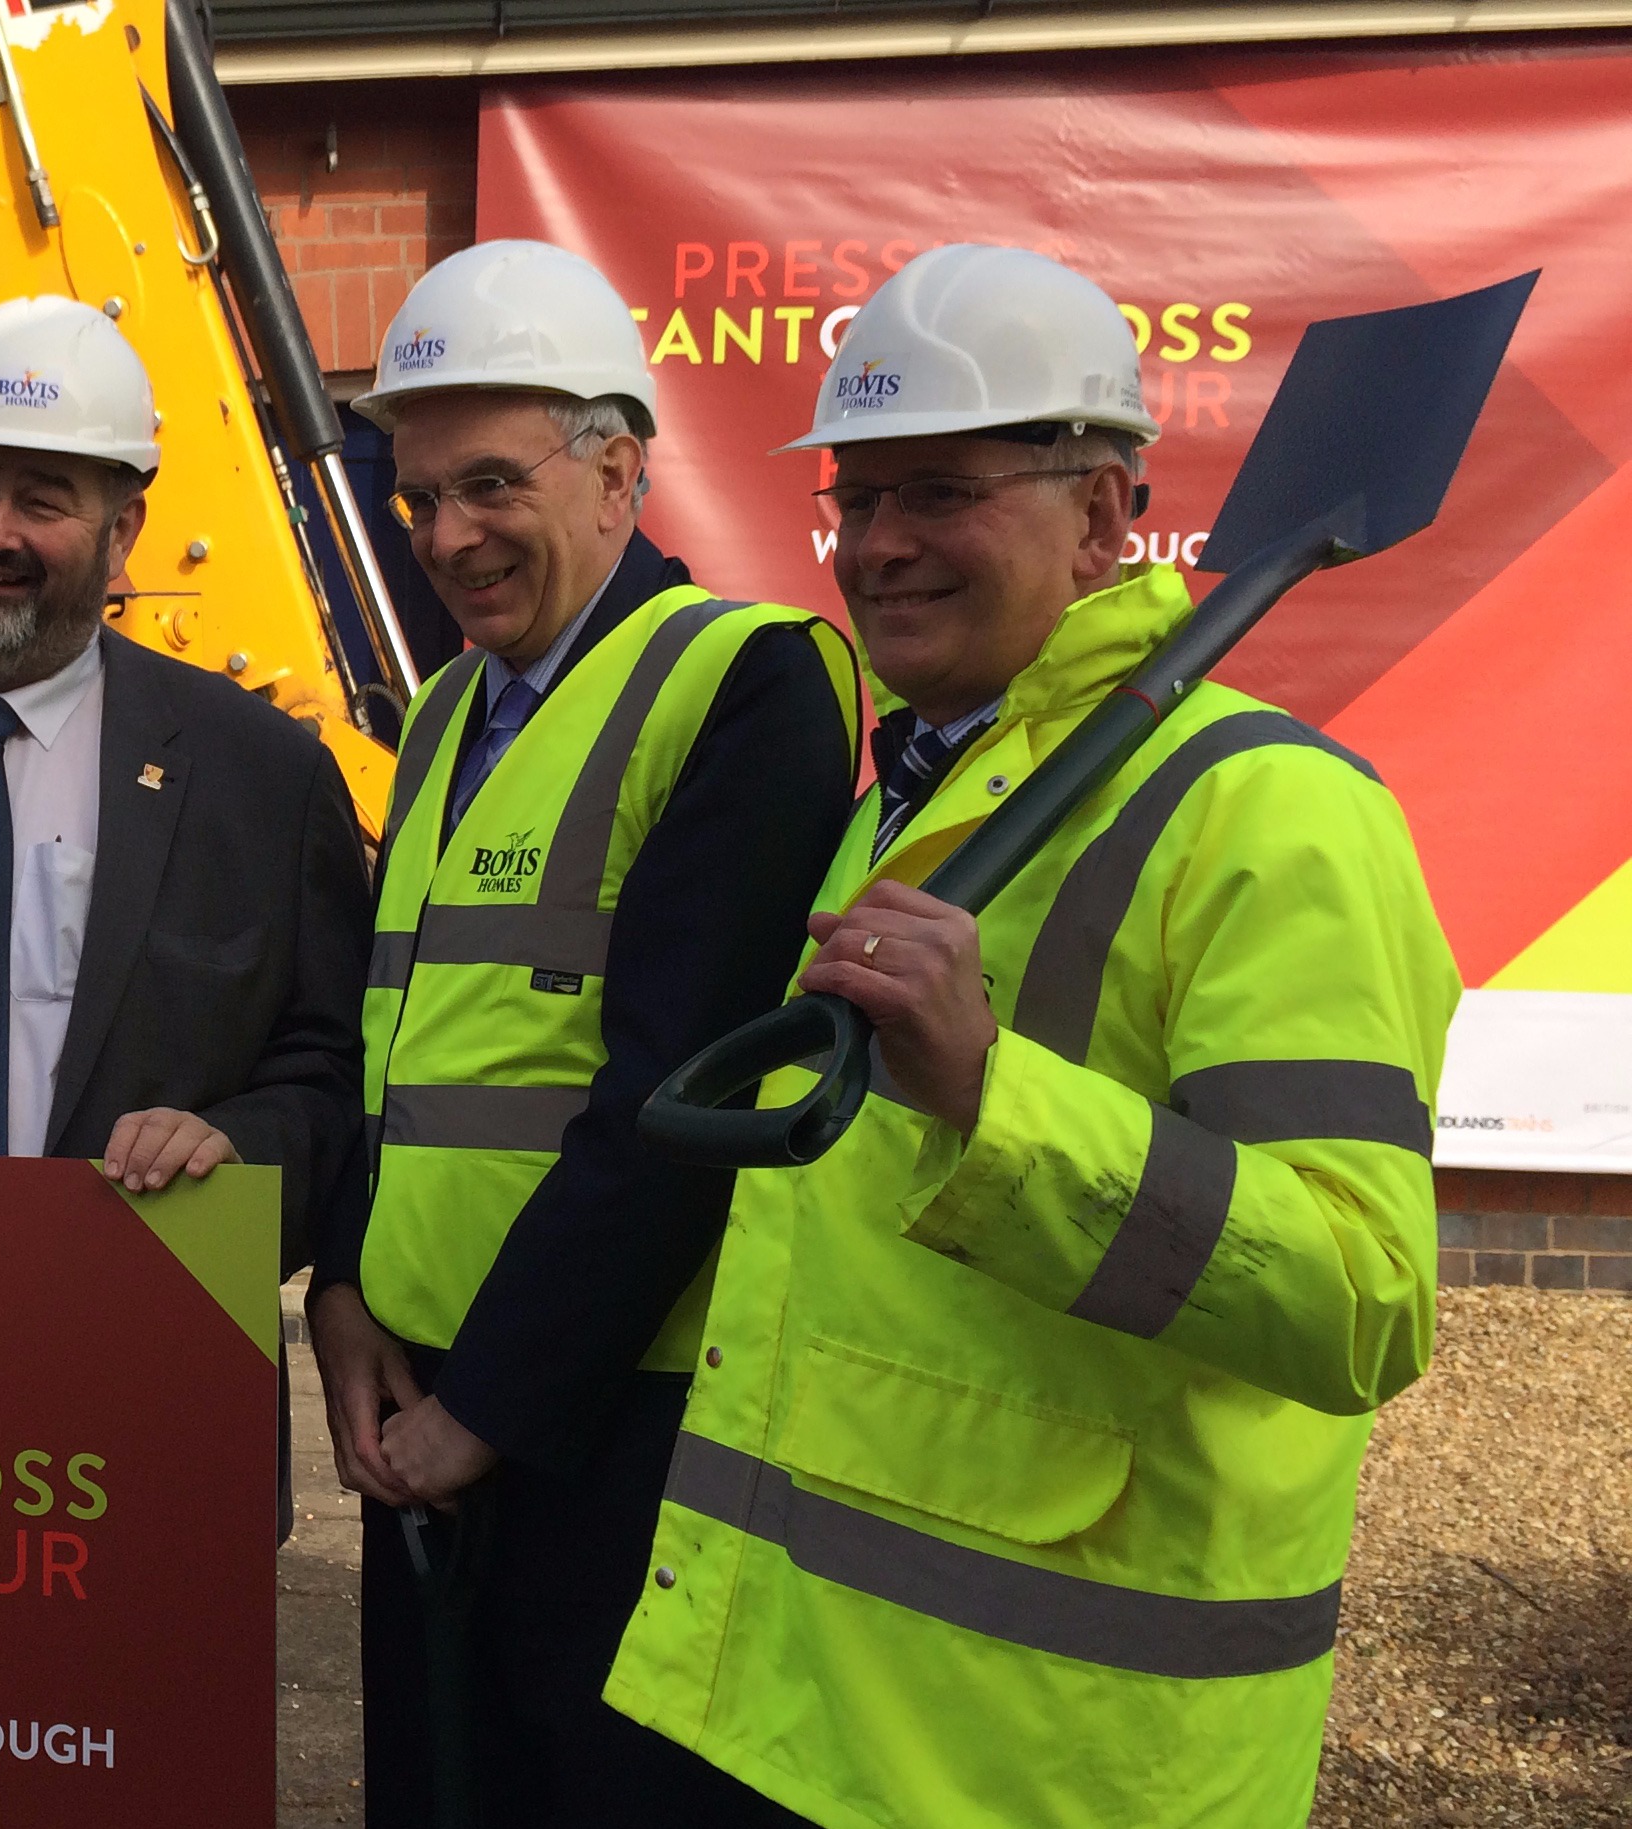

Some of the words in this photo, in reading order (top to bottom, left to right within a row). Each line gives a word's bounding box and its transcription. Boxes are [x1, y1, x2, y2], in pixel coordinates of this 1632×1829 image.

[393, 339, 446, 363] BOVIS
[399, 358, 434, 372] HOMES
[836, 373, 901, 398] BOVIS
[5, 396, 48, 409] HOMES
[840, 396, 885, 410] HOMES
[469, 847, 541, 877] BOVIS
[477, 877, 523, 893] HOMES
